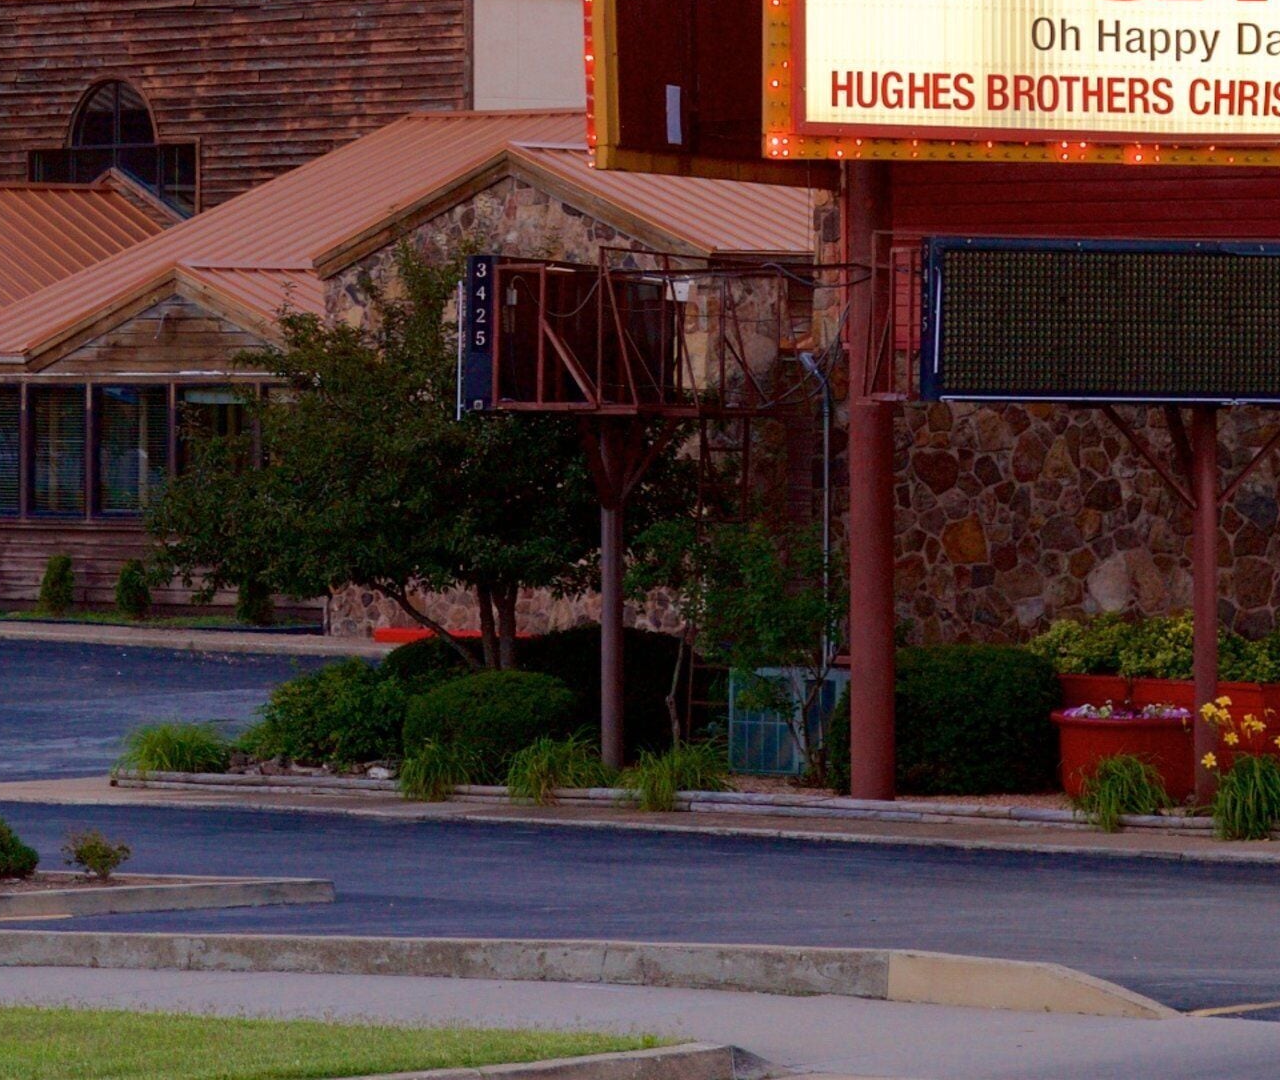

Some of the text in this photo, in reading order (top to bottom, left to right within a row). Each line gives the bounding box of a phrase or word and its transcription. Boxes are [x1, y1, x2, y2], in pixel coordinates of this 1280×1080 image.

[1031, 16, 1082, 52] Oh
[1097, 19, 1220, 63] Happy
[831, 70, 976, 111] HUGHES
[986, 73, 1175, 115] BROTHERS
